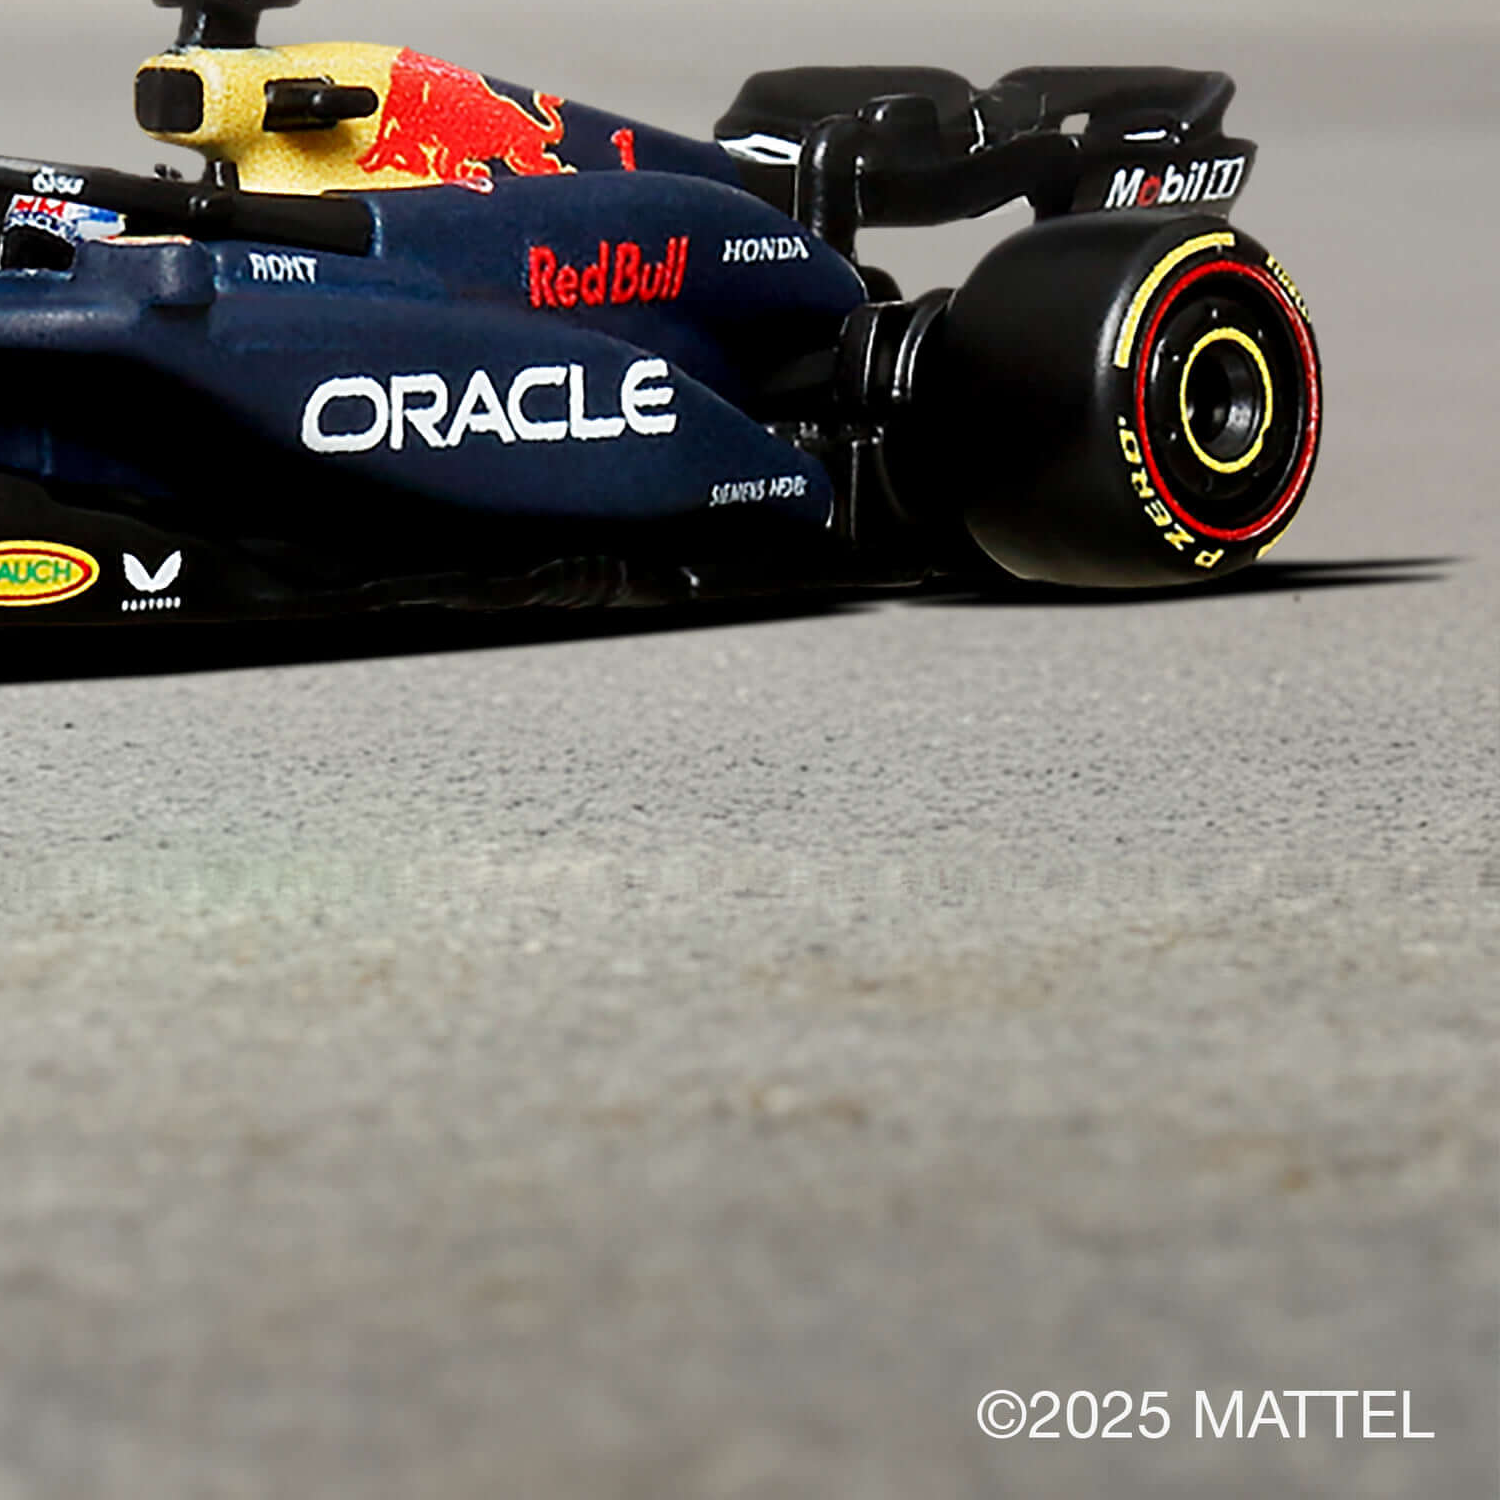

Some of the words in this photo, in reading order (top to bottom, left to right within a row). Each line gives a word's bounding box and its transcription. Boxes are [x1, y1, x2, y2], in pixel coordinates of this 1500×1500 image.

[1105, 161, 1209, 209] Mobil
[722, 236, 810, 262] HONDA
[301, 358, 677, 452] ORACLE
